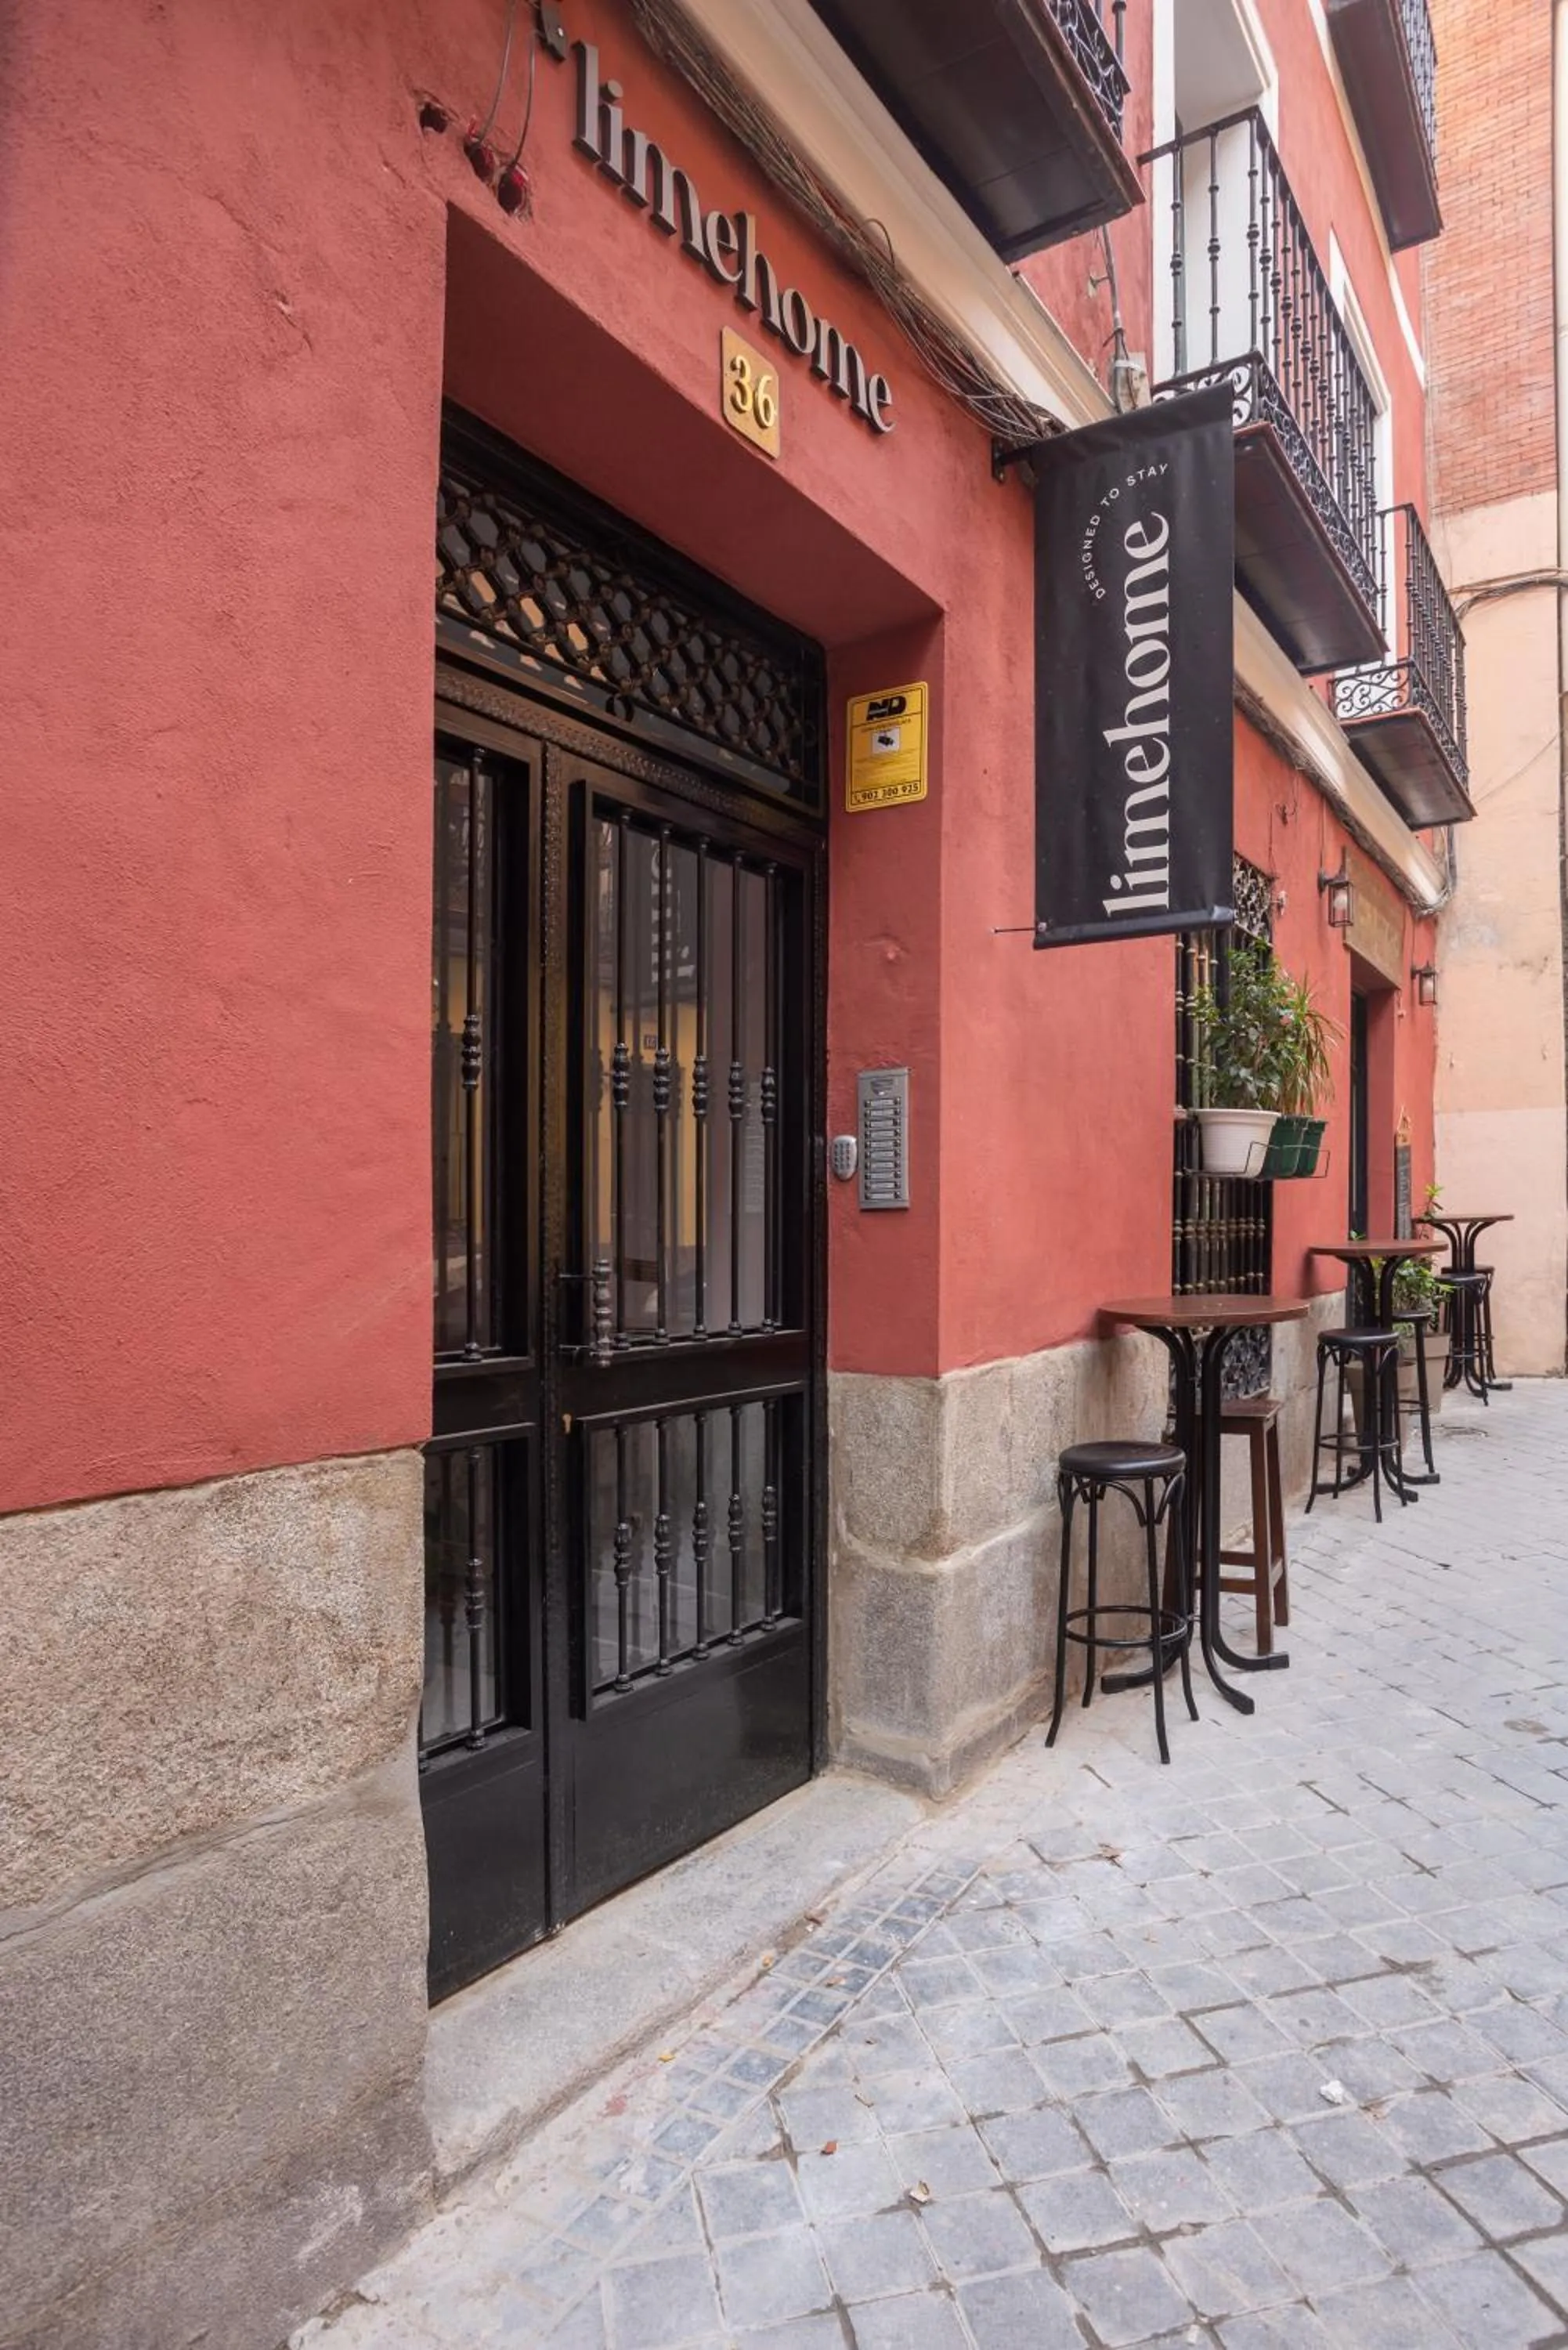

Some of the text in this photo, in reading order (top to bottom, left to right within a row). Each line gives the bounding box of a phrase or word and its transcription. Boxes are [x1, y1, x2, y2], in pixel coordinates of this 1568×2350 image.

[572, 39, 895, 434] limehome
[729, 354, 776, 428] 36
[1082, 463, 1168, 600] DESIGNED TO STAY
[1103, 512, 1171, 918] limehome
